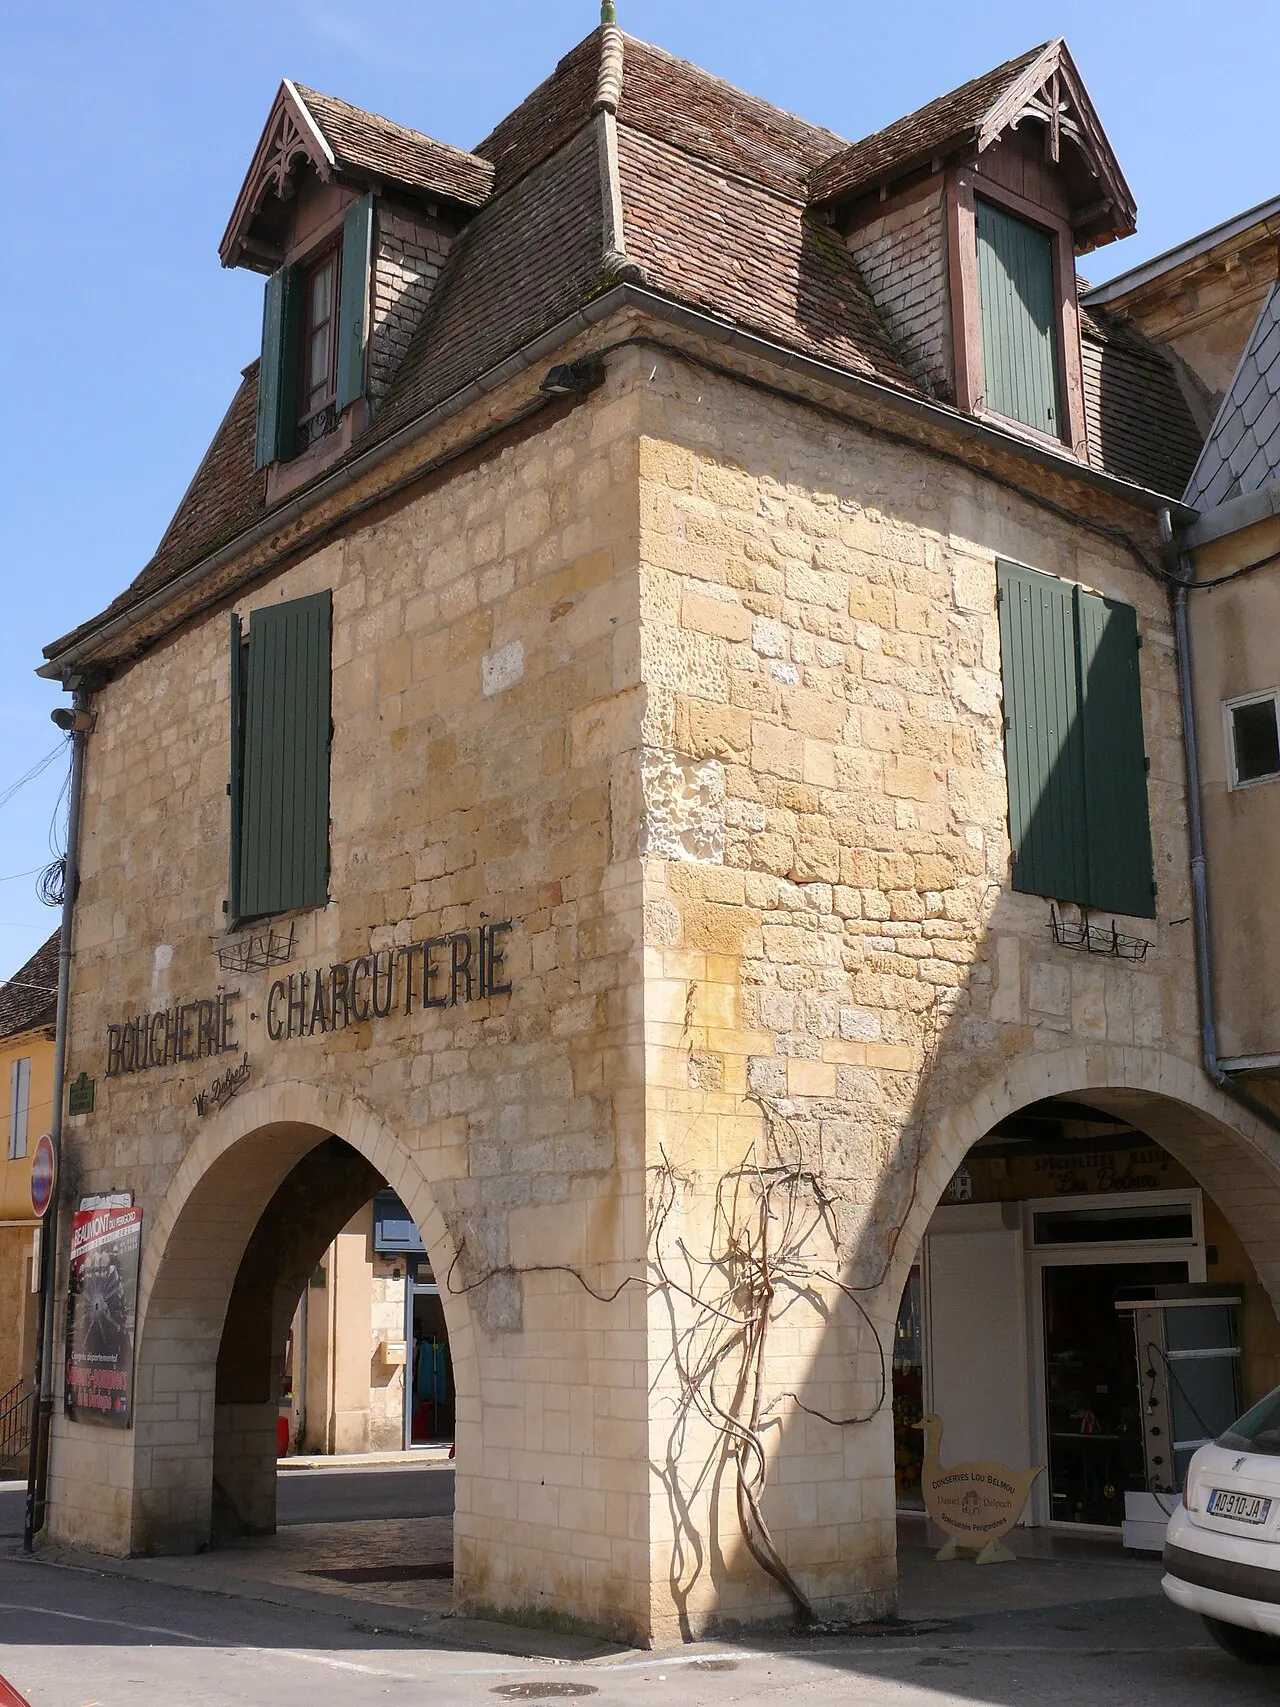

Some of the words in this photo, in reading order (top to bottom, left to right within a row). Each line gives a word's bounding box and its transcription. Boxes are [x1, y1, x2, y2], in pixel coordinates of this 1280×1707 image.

[104, 987, 240, 1078] BOUCHERIE
[267, 921, 513, 1041] CHARCUTERIE
[74, 1212, 110, 1247] BEAUMONT
[931, 1473, 969, 1490] CONSERVES
